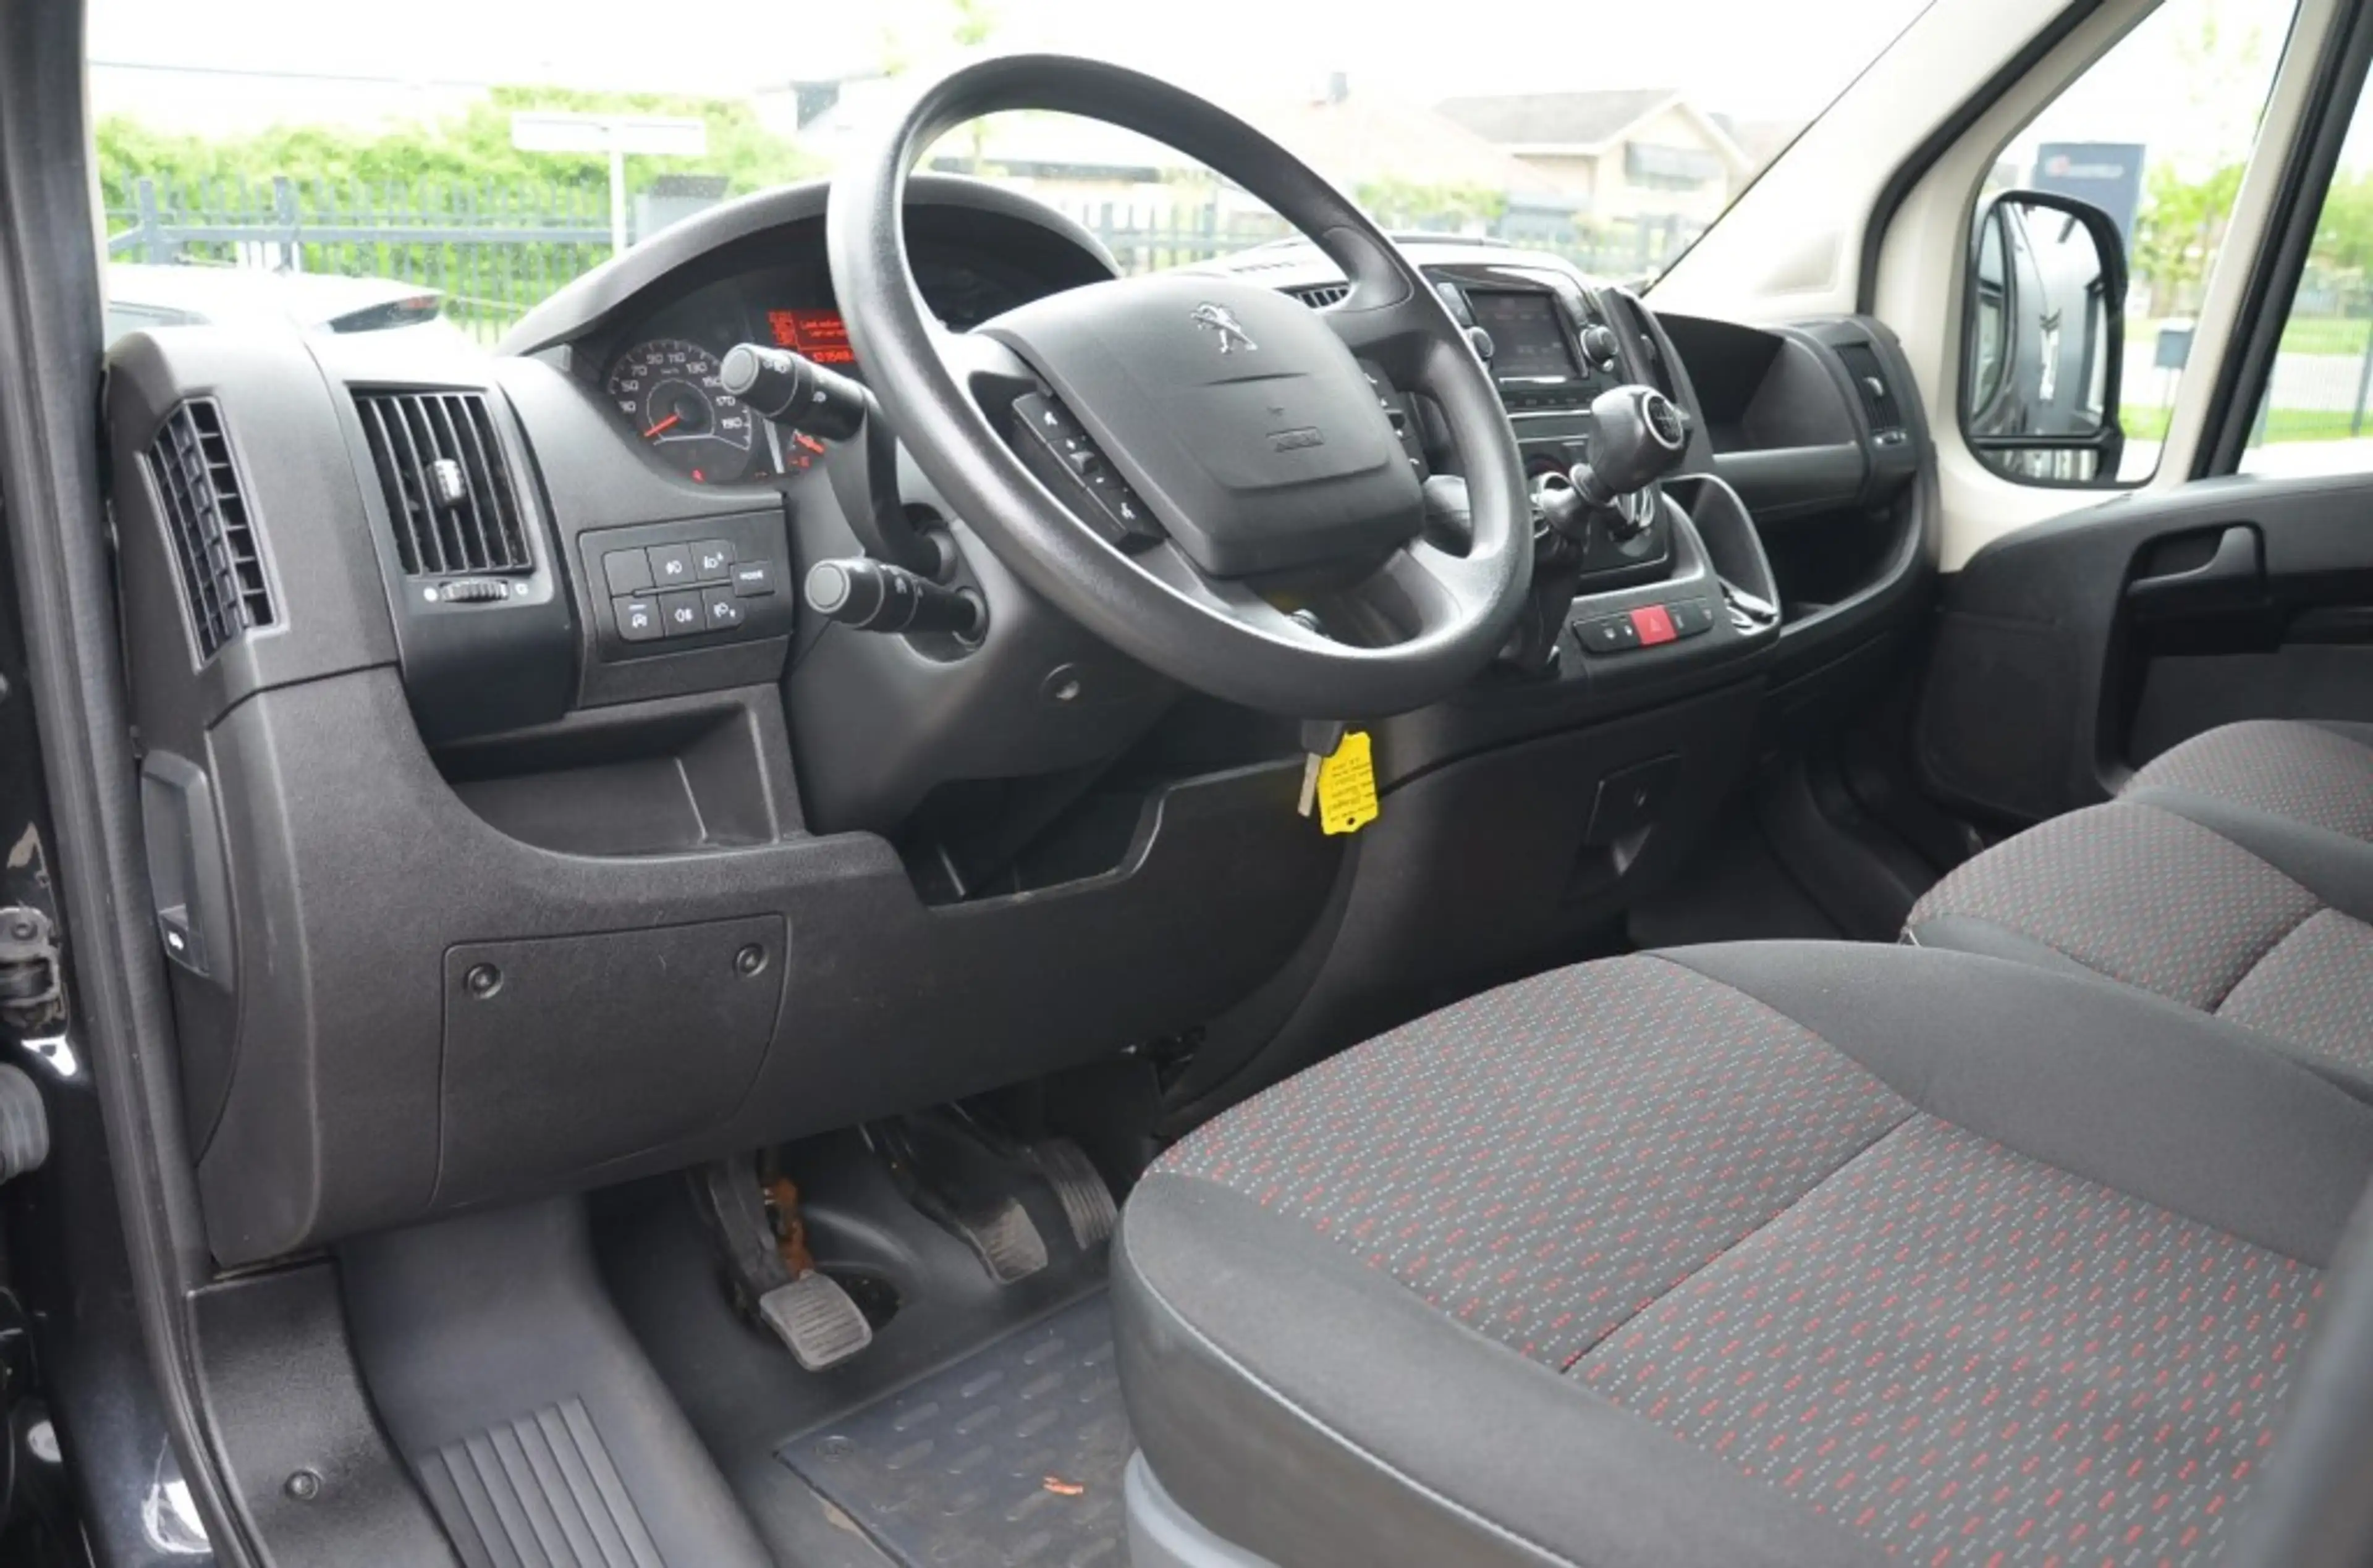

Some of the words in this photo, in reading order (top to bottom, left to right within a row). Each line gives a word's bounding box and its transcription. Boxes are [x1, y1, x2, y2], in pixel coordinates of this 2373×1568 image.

[646, 354, 664, 365] 90
[667, 352, 685, 363] 110
[631, 365, 648, 376] 70
[686, 361, 707, 374] 130
